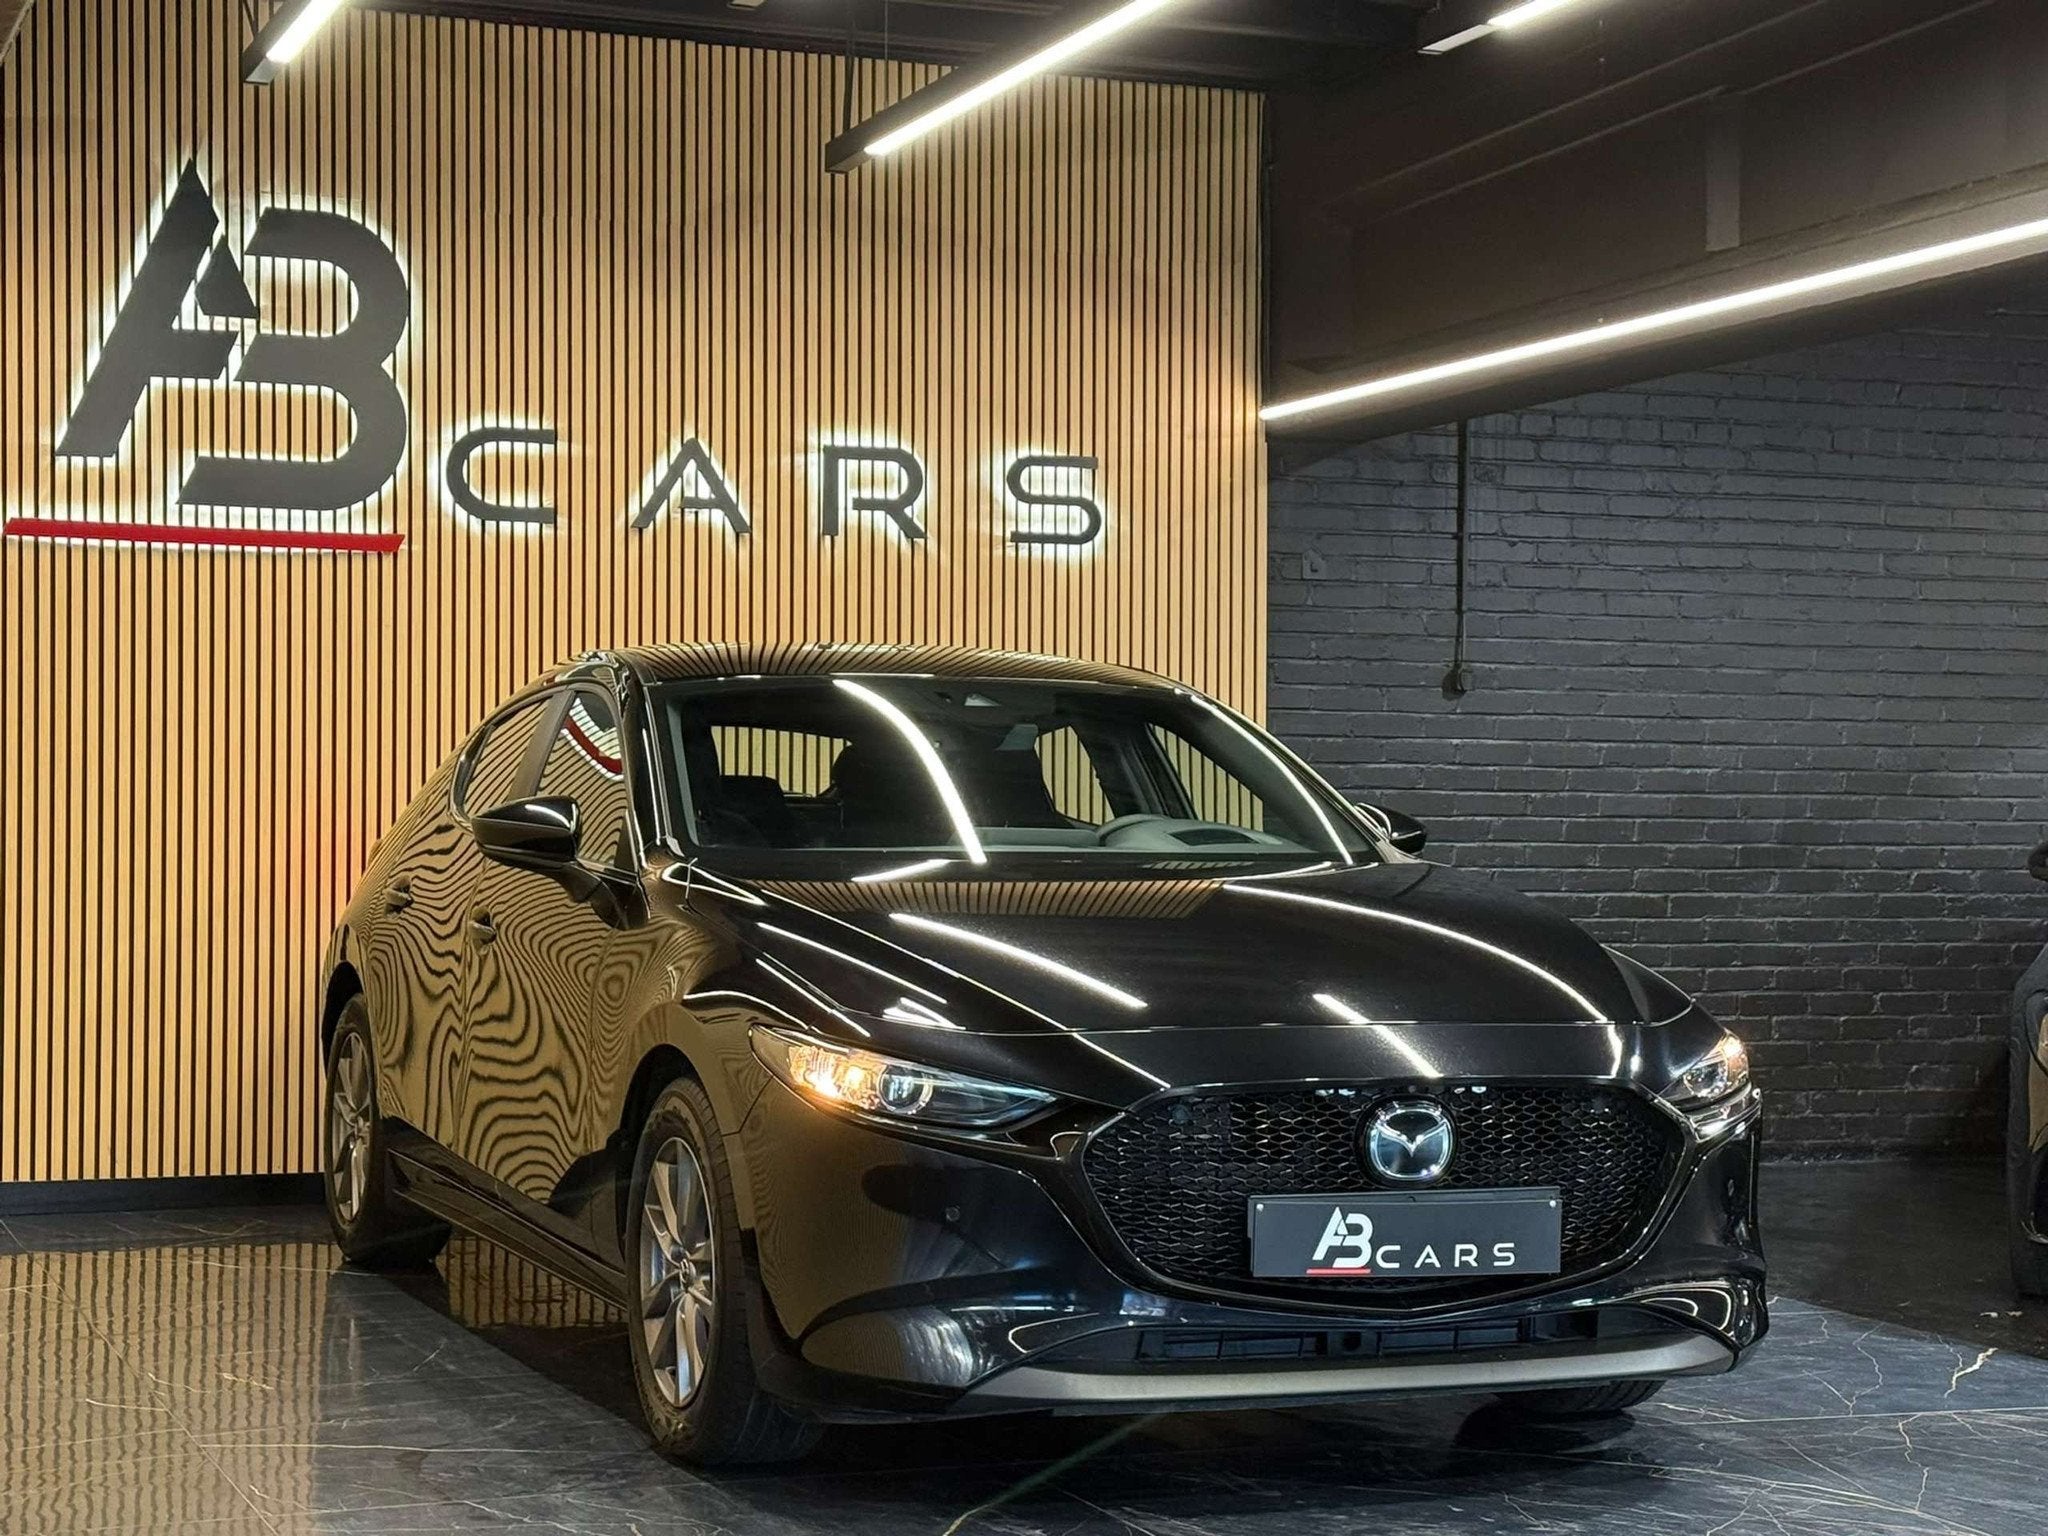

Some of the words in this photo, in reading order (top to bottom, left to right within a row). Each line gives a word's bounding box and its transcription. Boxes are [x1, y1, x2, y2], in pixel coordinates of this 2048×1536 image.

[54, 158, 410, 511] AB
[446, 427, 1100, 544] CARS
[1312, 1206, 1373, 1268] AB
[1376, 1243, 1515, 1268] CARS
